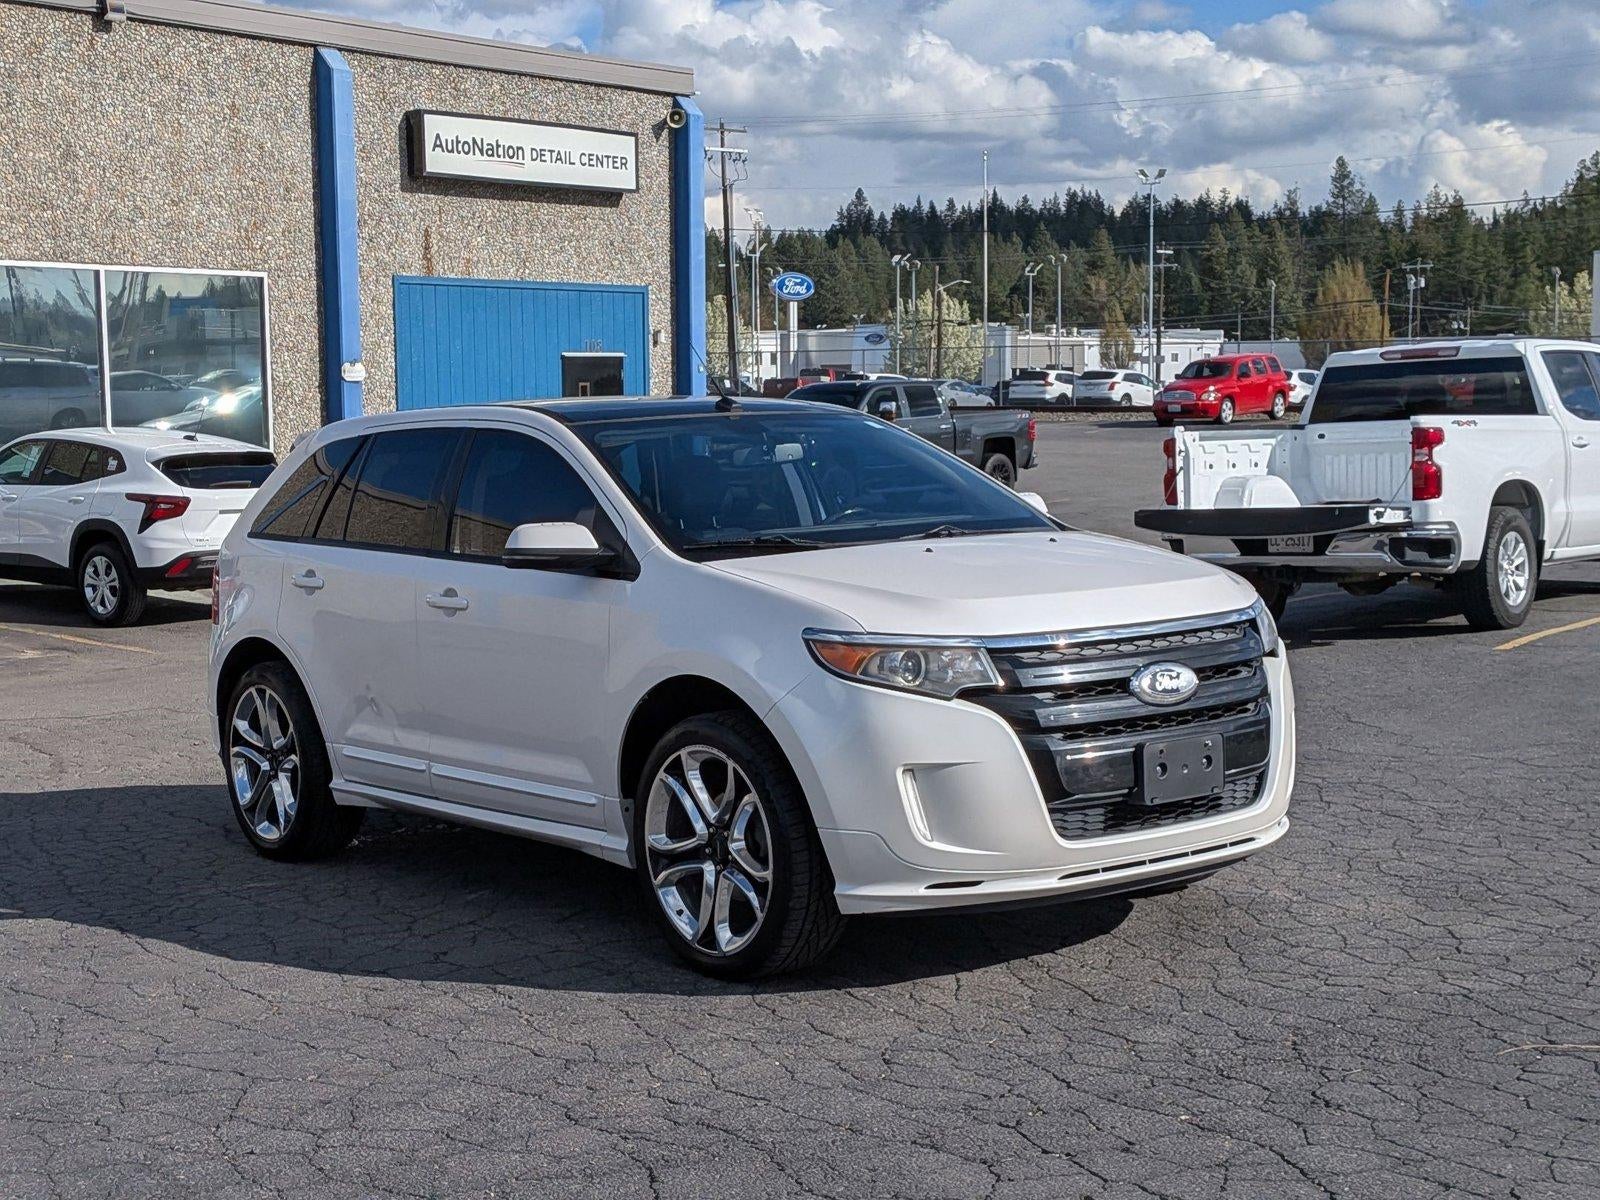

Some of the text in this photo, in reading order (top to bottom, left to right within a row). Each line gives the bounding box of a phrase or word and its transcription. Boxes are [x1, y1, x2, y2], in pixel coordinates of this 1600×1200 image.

[432, 132, 629, 170] AutoNation DETAIL CENTER
[782, 277, 808, 294] Ford
[1155, 671, 1182, 691] Ford
